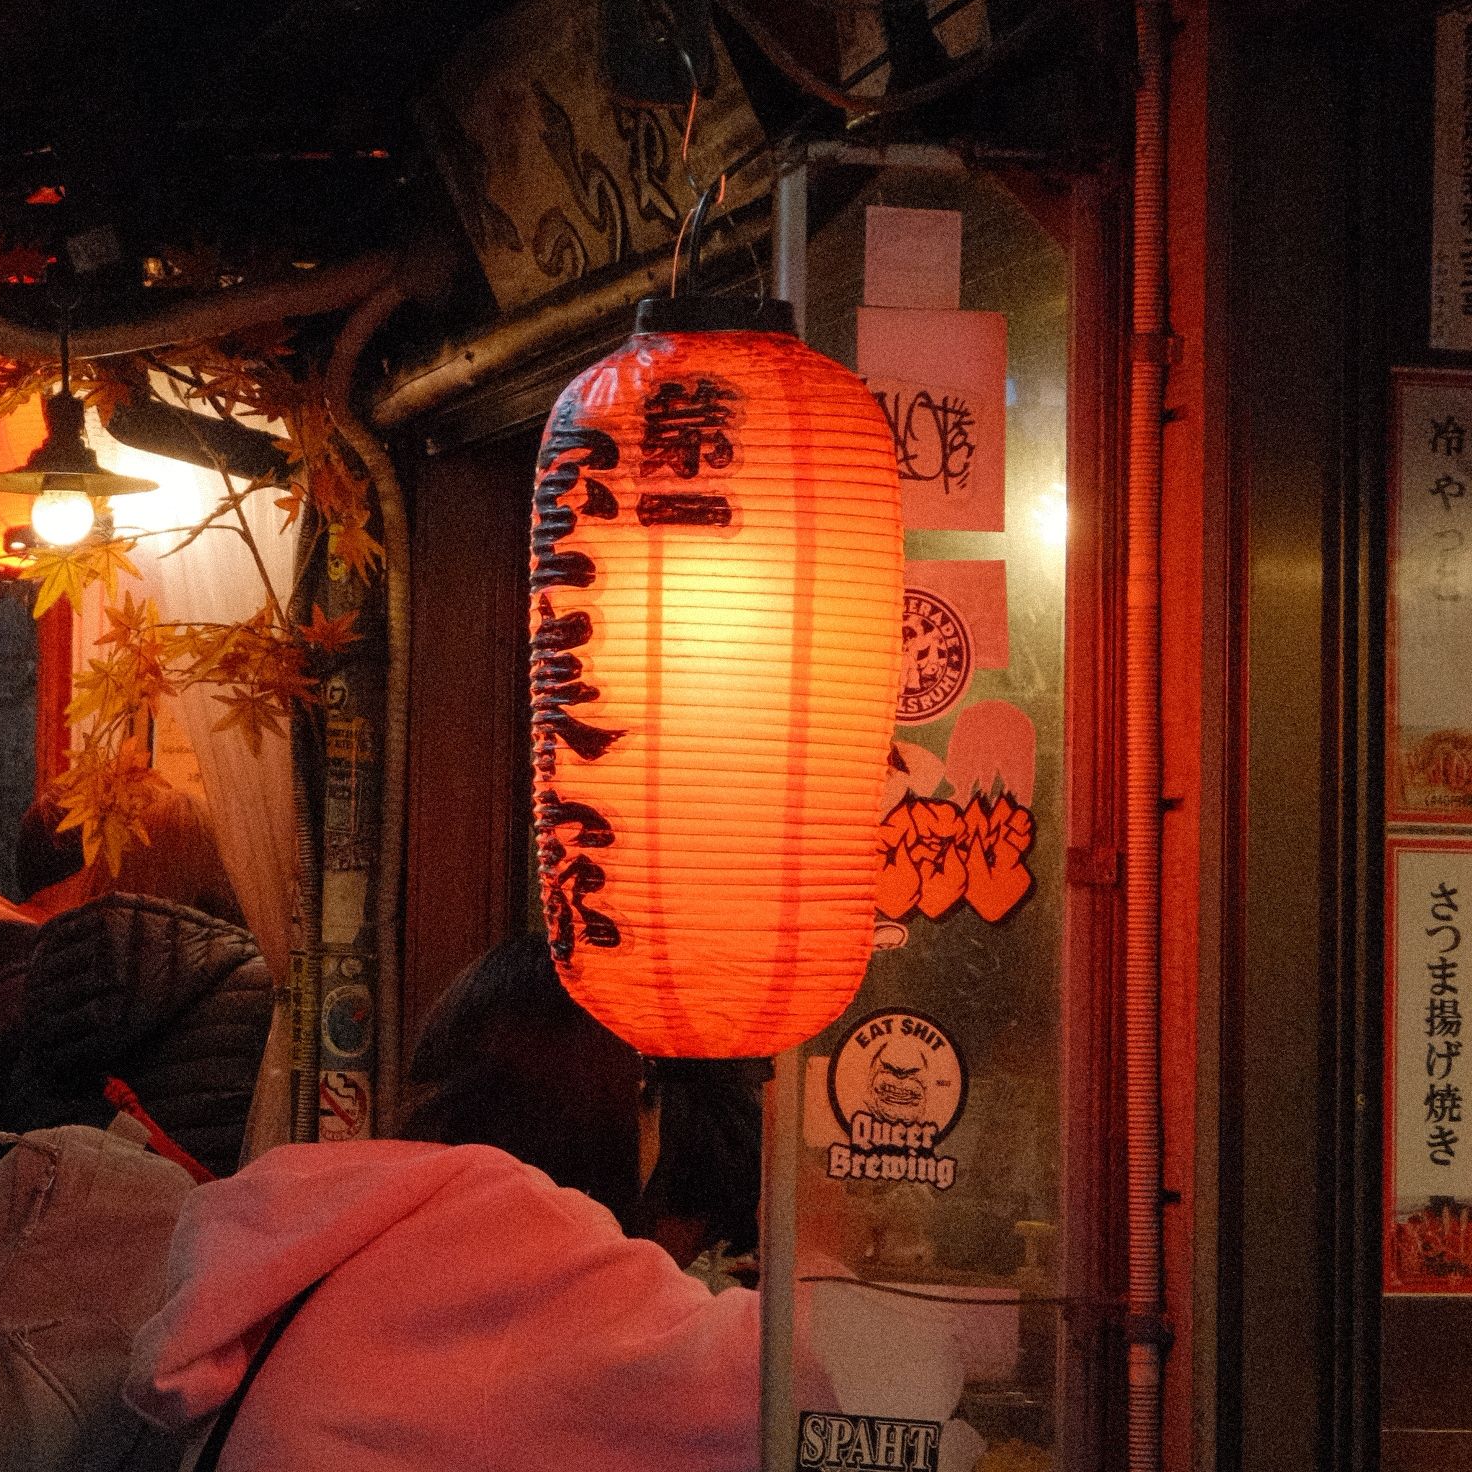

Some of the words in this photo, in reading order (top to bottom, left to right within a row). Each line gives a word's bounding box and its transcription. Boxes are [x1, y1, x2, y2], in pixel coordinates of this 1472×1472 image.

[635, 378, 737, 529] 第一
[902, 597, 961, 649] ERADE
[854, 1018, 894, 1050] EAT
[1423, 880, 1464, 1168] さつま揚げ焼き
[851, 1112, 938, 1151] Queer
[828, 1143, 957, 1189] Brewing
